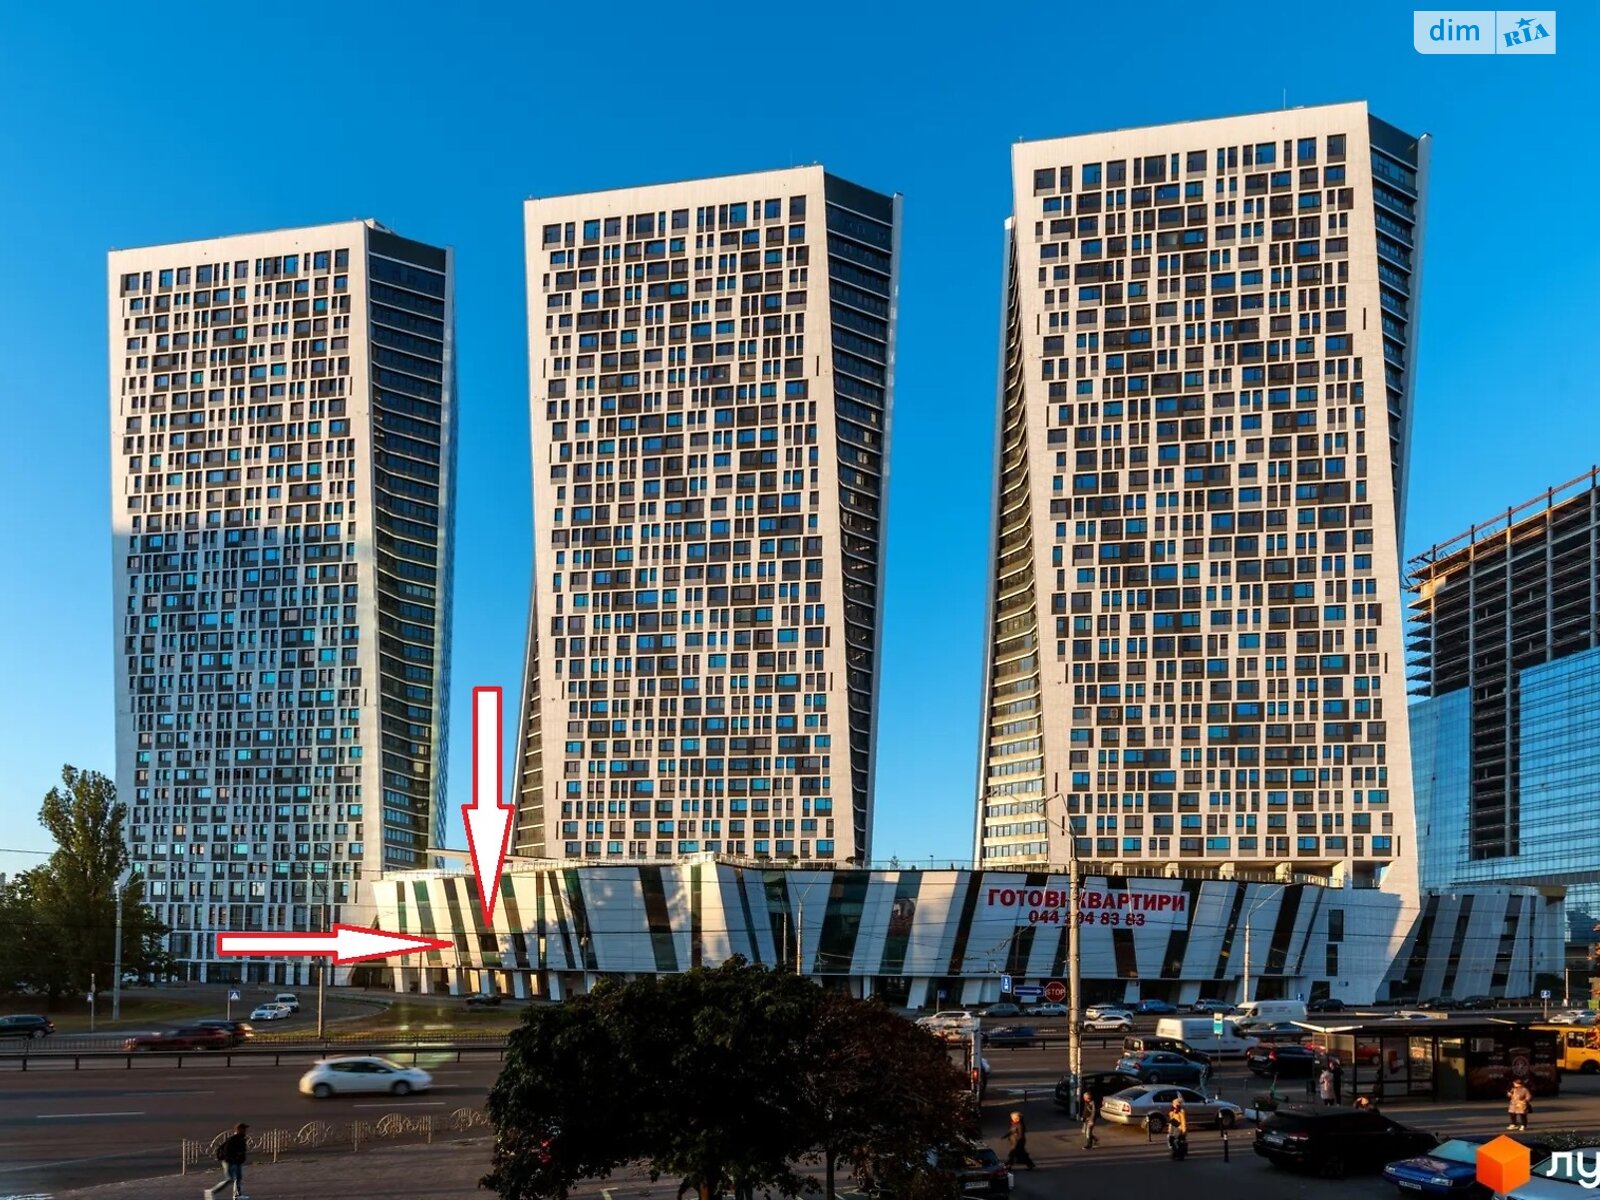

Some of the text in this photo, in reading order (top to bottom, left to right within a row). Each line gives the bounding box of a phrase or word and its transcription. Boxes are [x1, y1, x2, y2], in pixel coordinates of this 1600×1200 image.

[1028, 910, 1059, 924] 044
[1100, 911, 1120, 926] 83
[1125, 912, 1145, 927] 83
[1046, 988, 1065, 996] STOP
